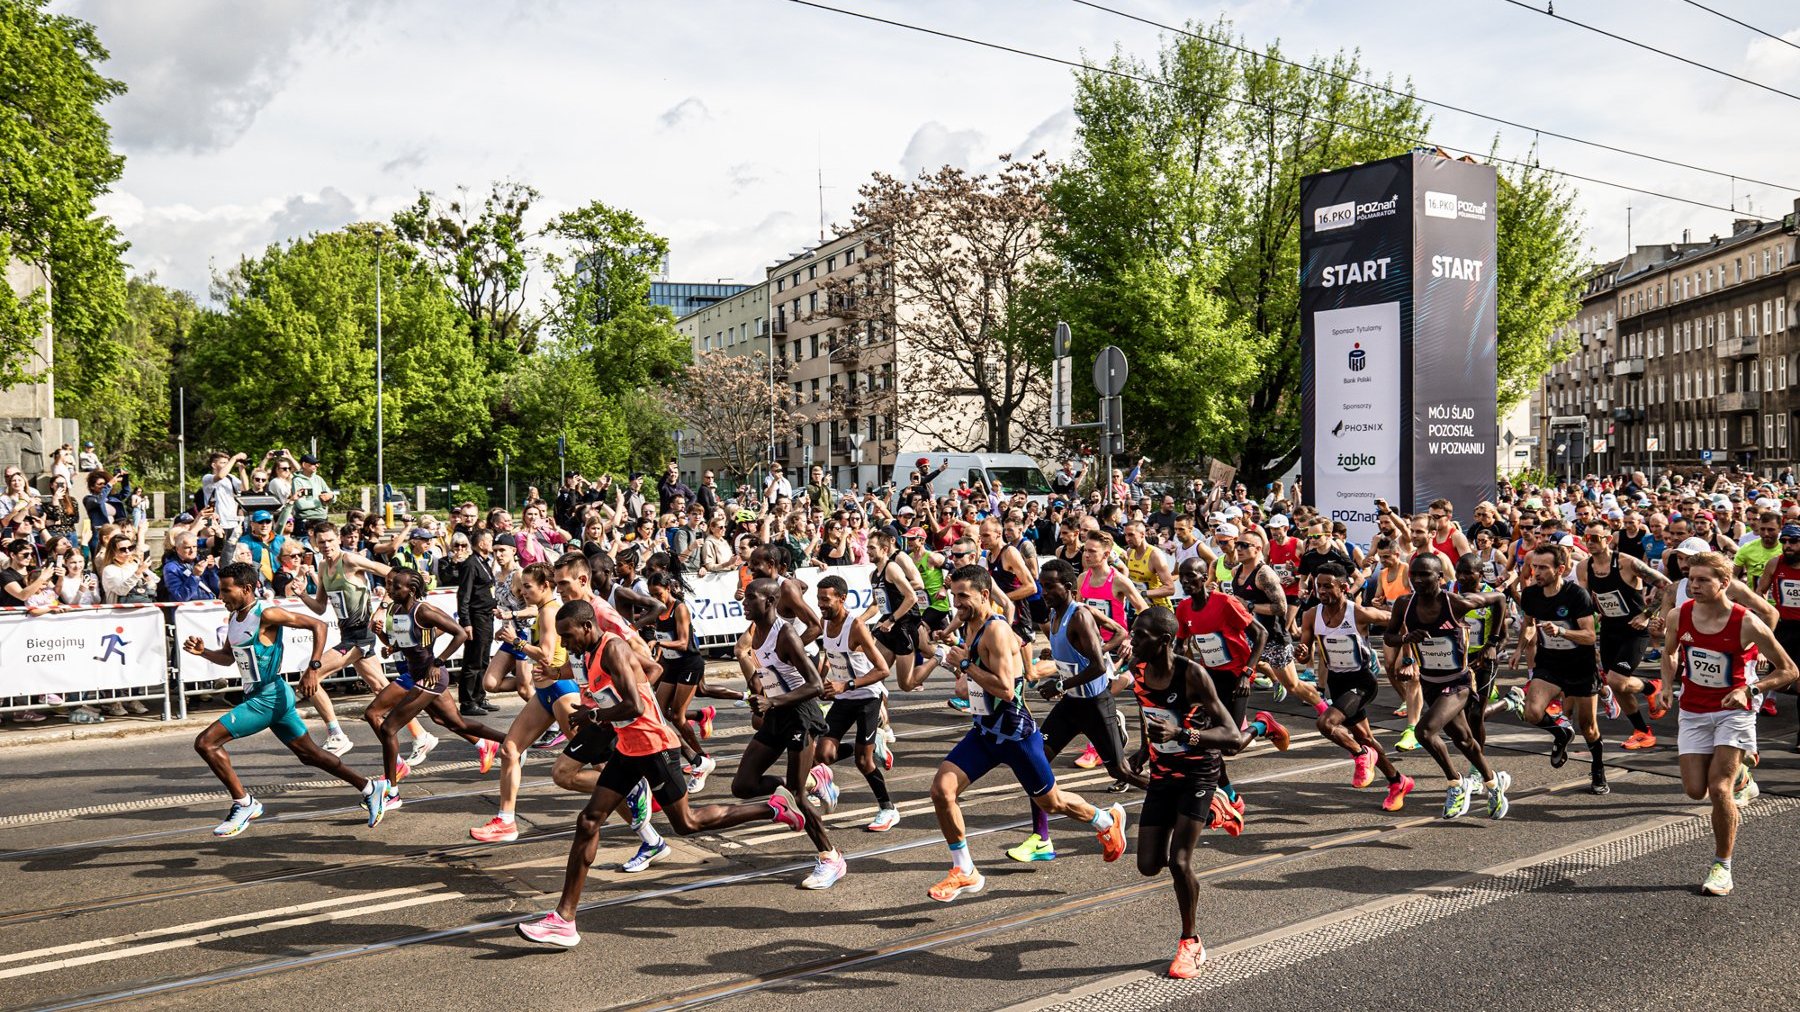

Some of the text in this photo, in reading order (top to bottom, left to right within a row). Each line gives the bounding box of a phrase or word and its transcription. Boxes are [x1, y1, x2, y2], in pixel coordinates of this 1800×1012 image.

[1318, 210, 1352, 224] 16.PKO
[1322, 257, 1391, 287] START
[1432, 255, 1482, 282] START
[1332, 325, 1382, 336] Sponsor Tytularny
[1428, 404, 1475, 419] MÓJ ŚLAD
[1344, 423, 1383, 432] PHO3NIX
[1428, 424, 1474, 437] POZOSTAŁ
[1428, 442, 1485, 455] W POZNANIU
[1703, 451, 1710, 459] P
[1337, 453, 1376, 466] żabka
[26, 637, 85, 651] Biegajmy
[26, 652, 66, 663] razem
[1694, 660, 1721, 674] 9761
